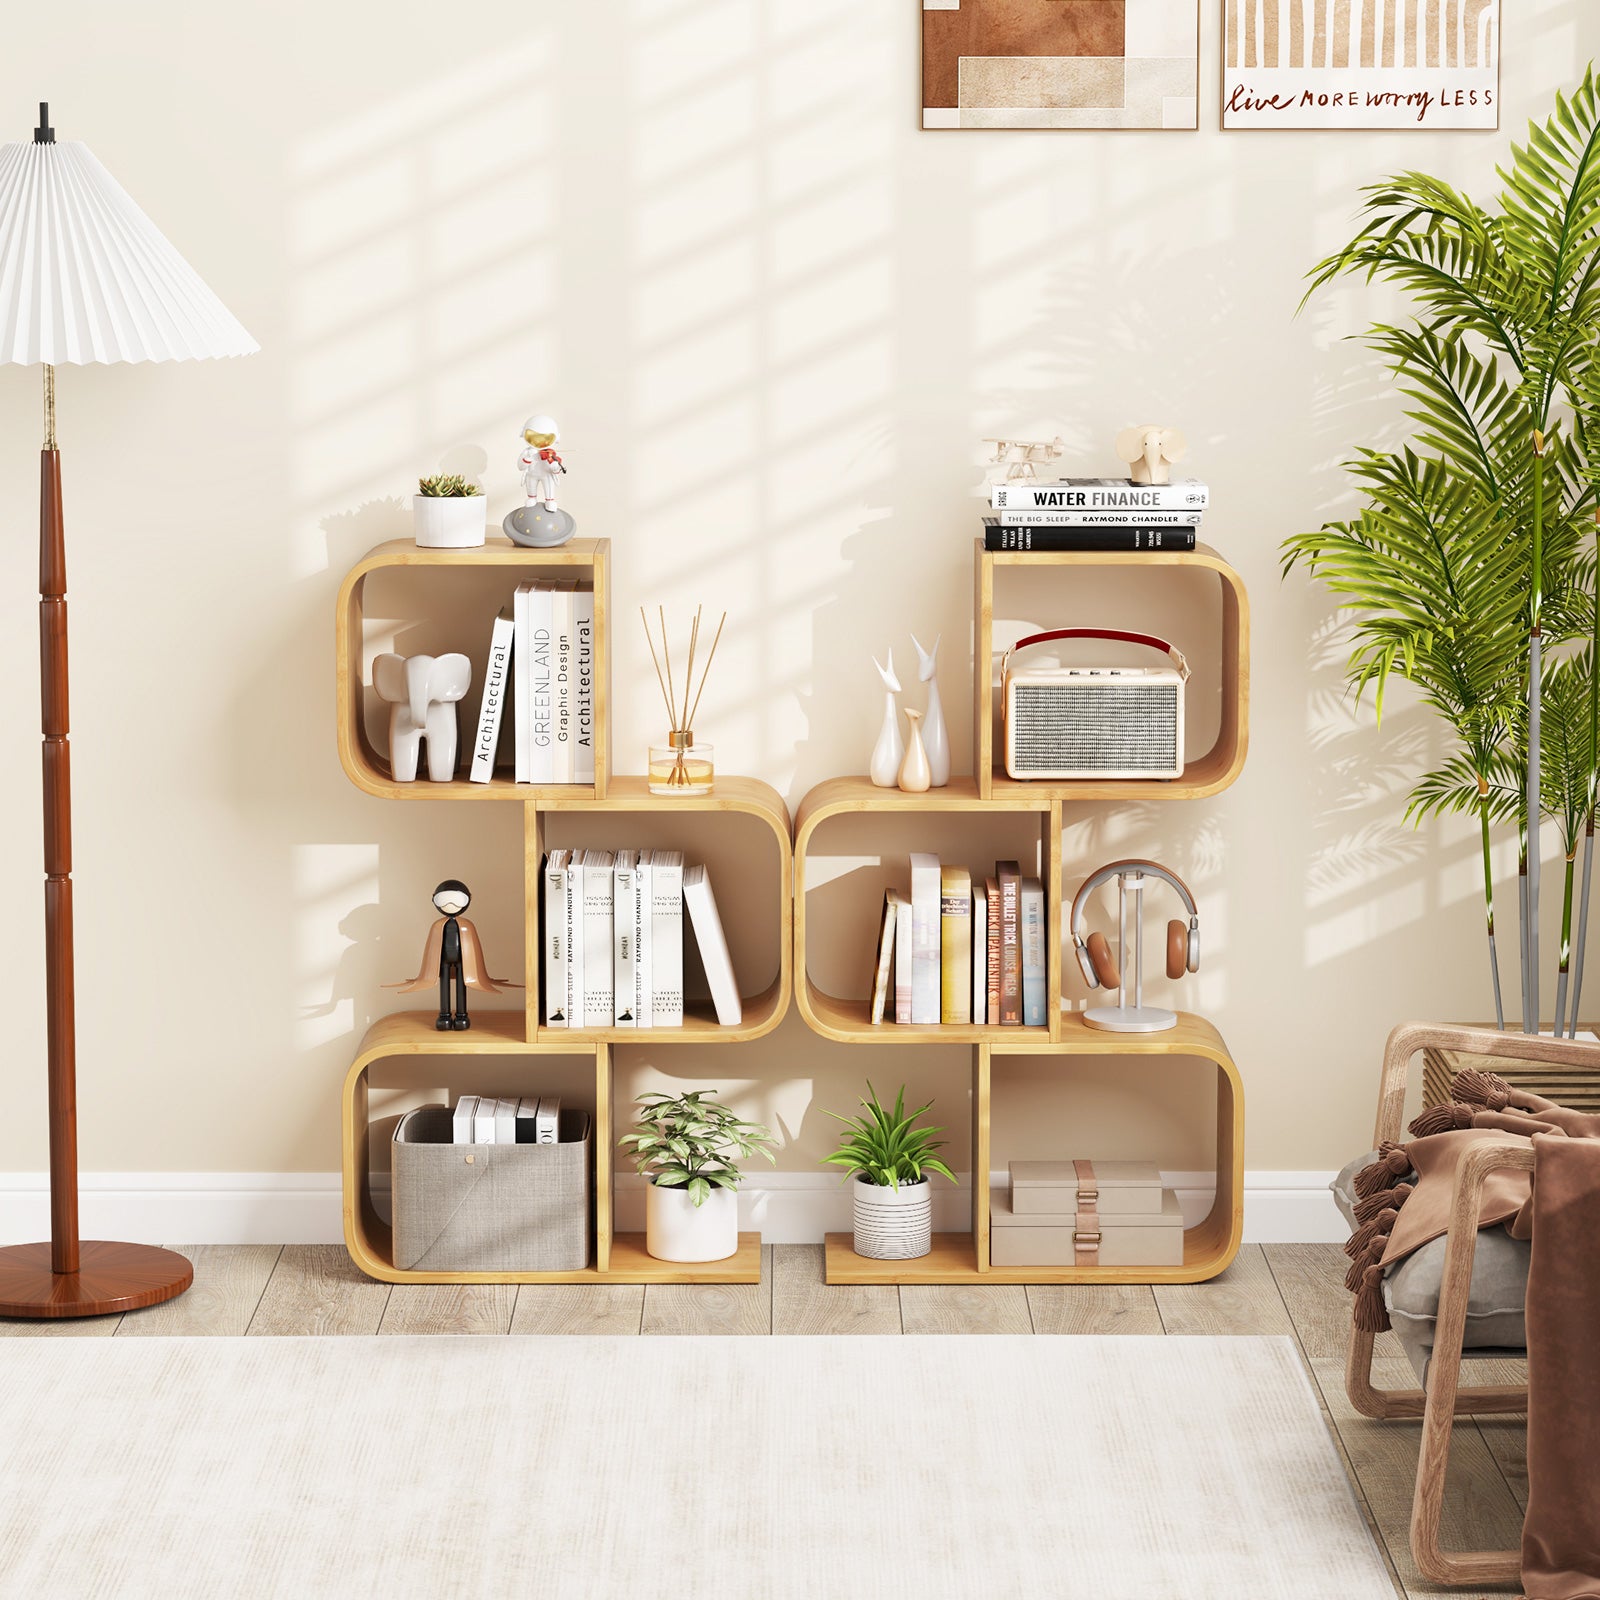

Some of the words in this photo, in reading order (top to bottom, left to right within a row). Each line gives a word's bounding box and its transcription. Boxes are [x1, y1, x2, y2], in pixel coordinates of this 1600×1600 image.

[1224, 83, 1296, 113] live
[1300, 90, 1359, 107] MORE
[1366, 91, 1434, 121] worry
[1440, 88, 1492, 106] LESS
[1034, 492, 1086, 506] WATER
[1092, 492, 1161, 506] FINANCE
[558, 635, 570, 682] Design
[534, 629, 550, 746] GREENLAND
[577, 618, 591, 747] Architectural
[477, 645, 506, 762] Architectural
[558, 688, 570, 742] Graphic
[1004, 882, 1016, 896] THE
[1004, 896, 1016, 922] BULLET
[1004, 923, 1016, 945] TRICK
[988, 939, 1000, 993] PALAHNIUK
[1004, 946, 1016, 971] LOUISE
[1005, 972, 1017, 996] WELSH
